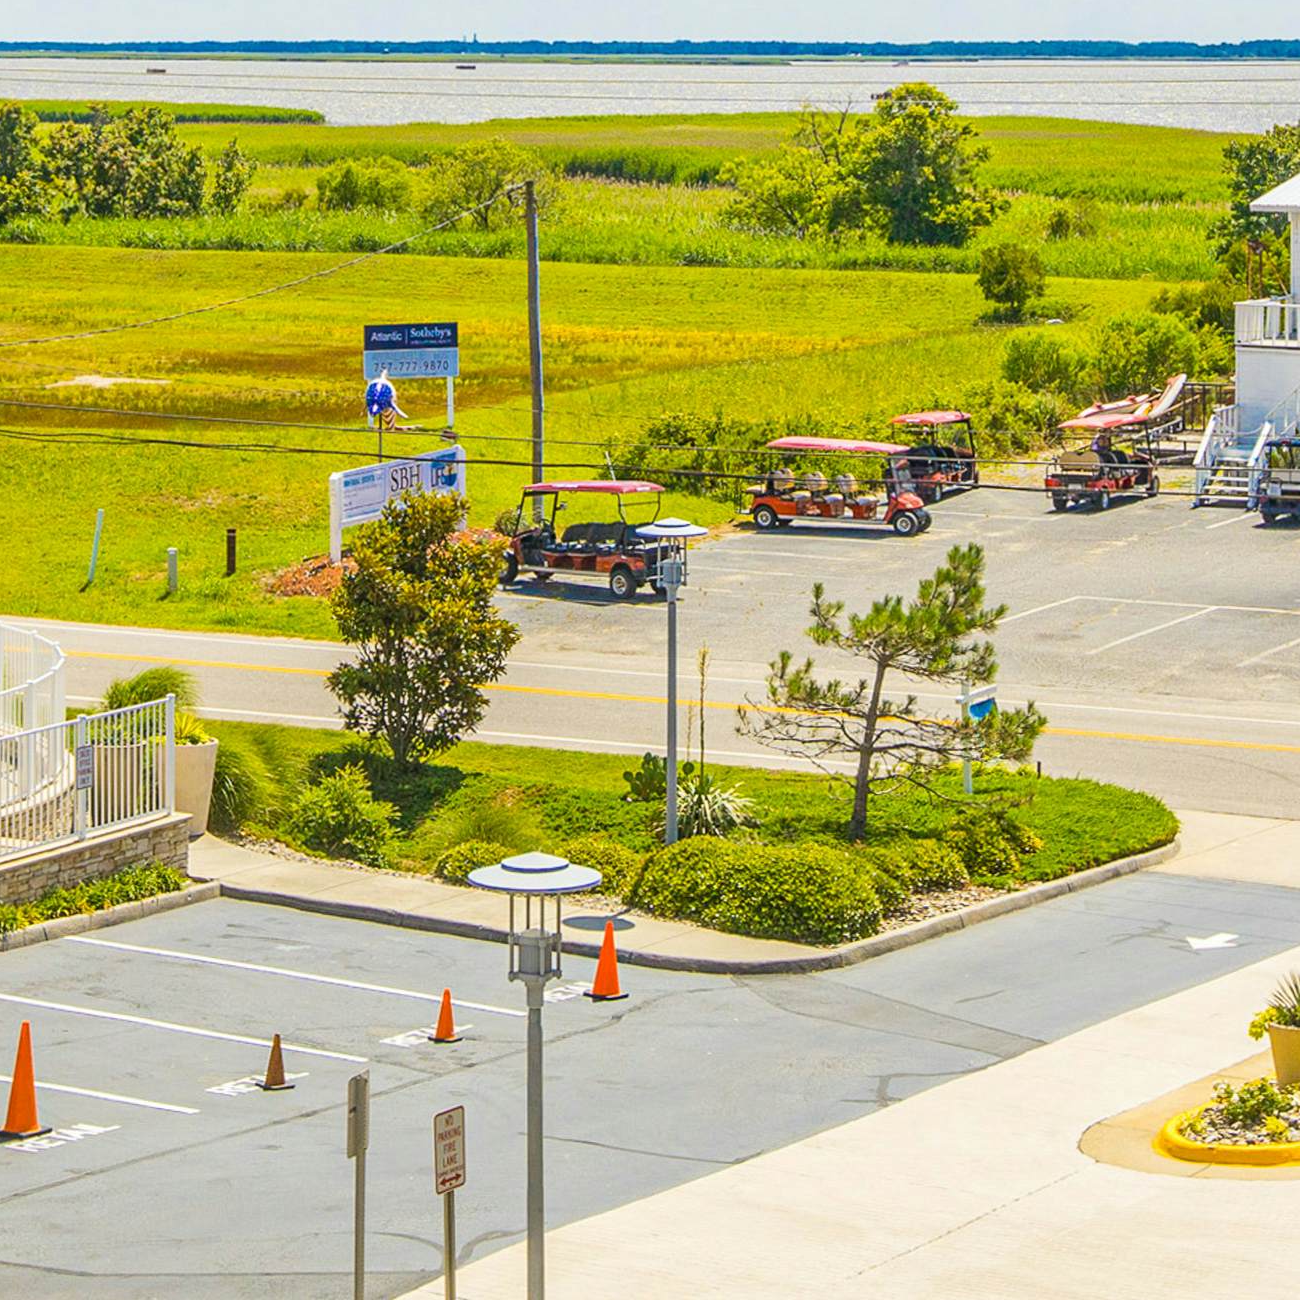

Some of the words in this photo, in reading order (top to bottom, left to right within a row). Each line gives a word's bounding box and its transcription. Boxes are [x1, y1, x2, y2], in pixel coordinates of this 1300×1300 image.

[370, 331, 403, 342] Atlantic
[410, 326, 452, 339] Sotheby's
[390, 463, 421, 492] SBH
[444, 1113, 454, 1126] NO
[438, 1126, 461, 1142] PARKING
[443, 1140, 456, 1153] FIRE
[443, 1153, 458, 1168] LANE
